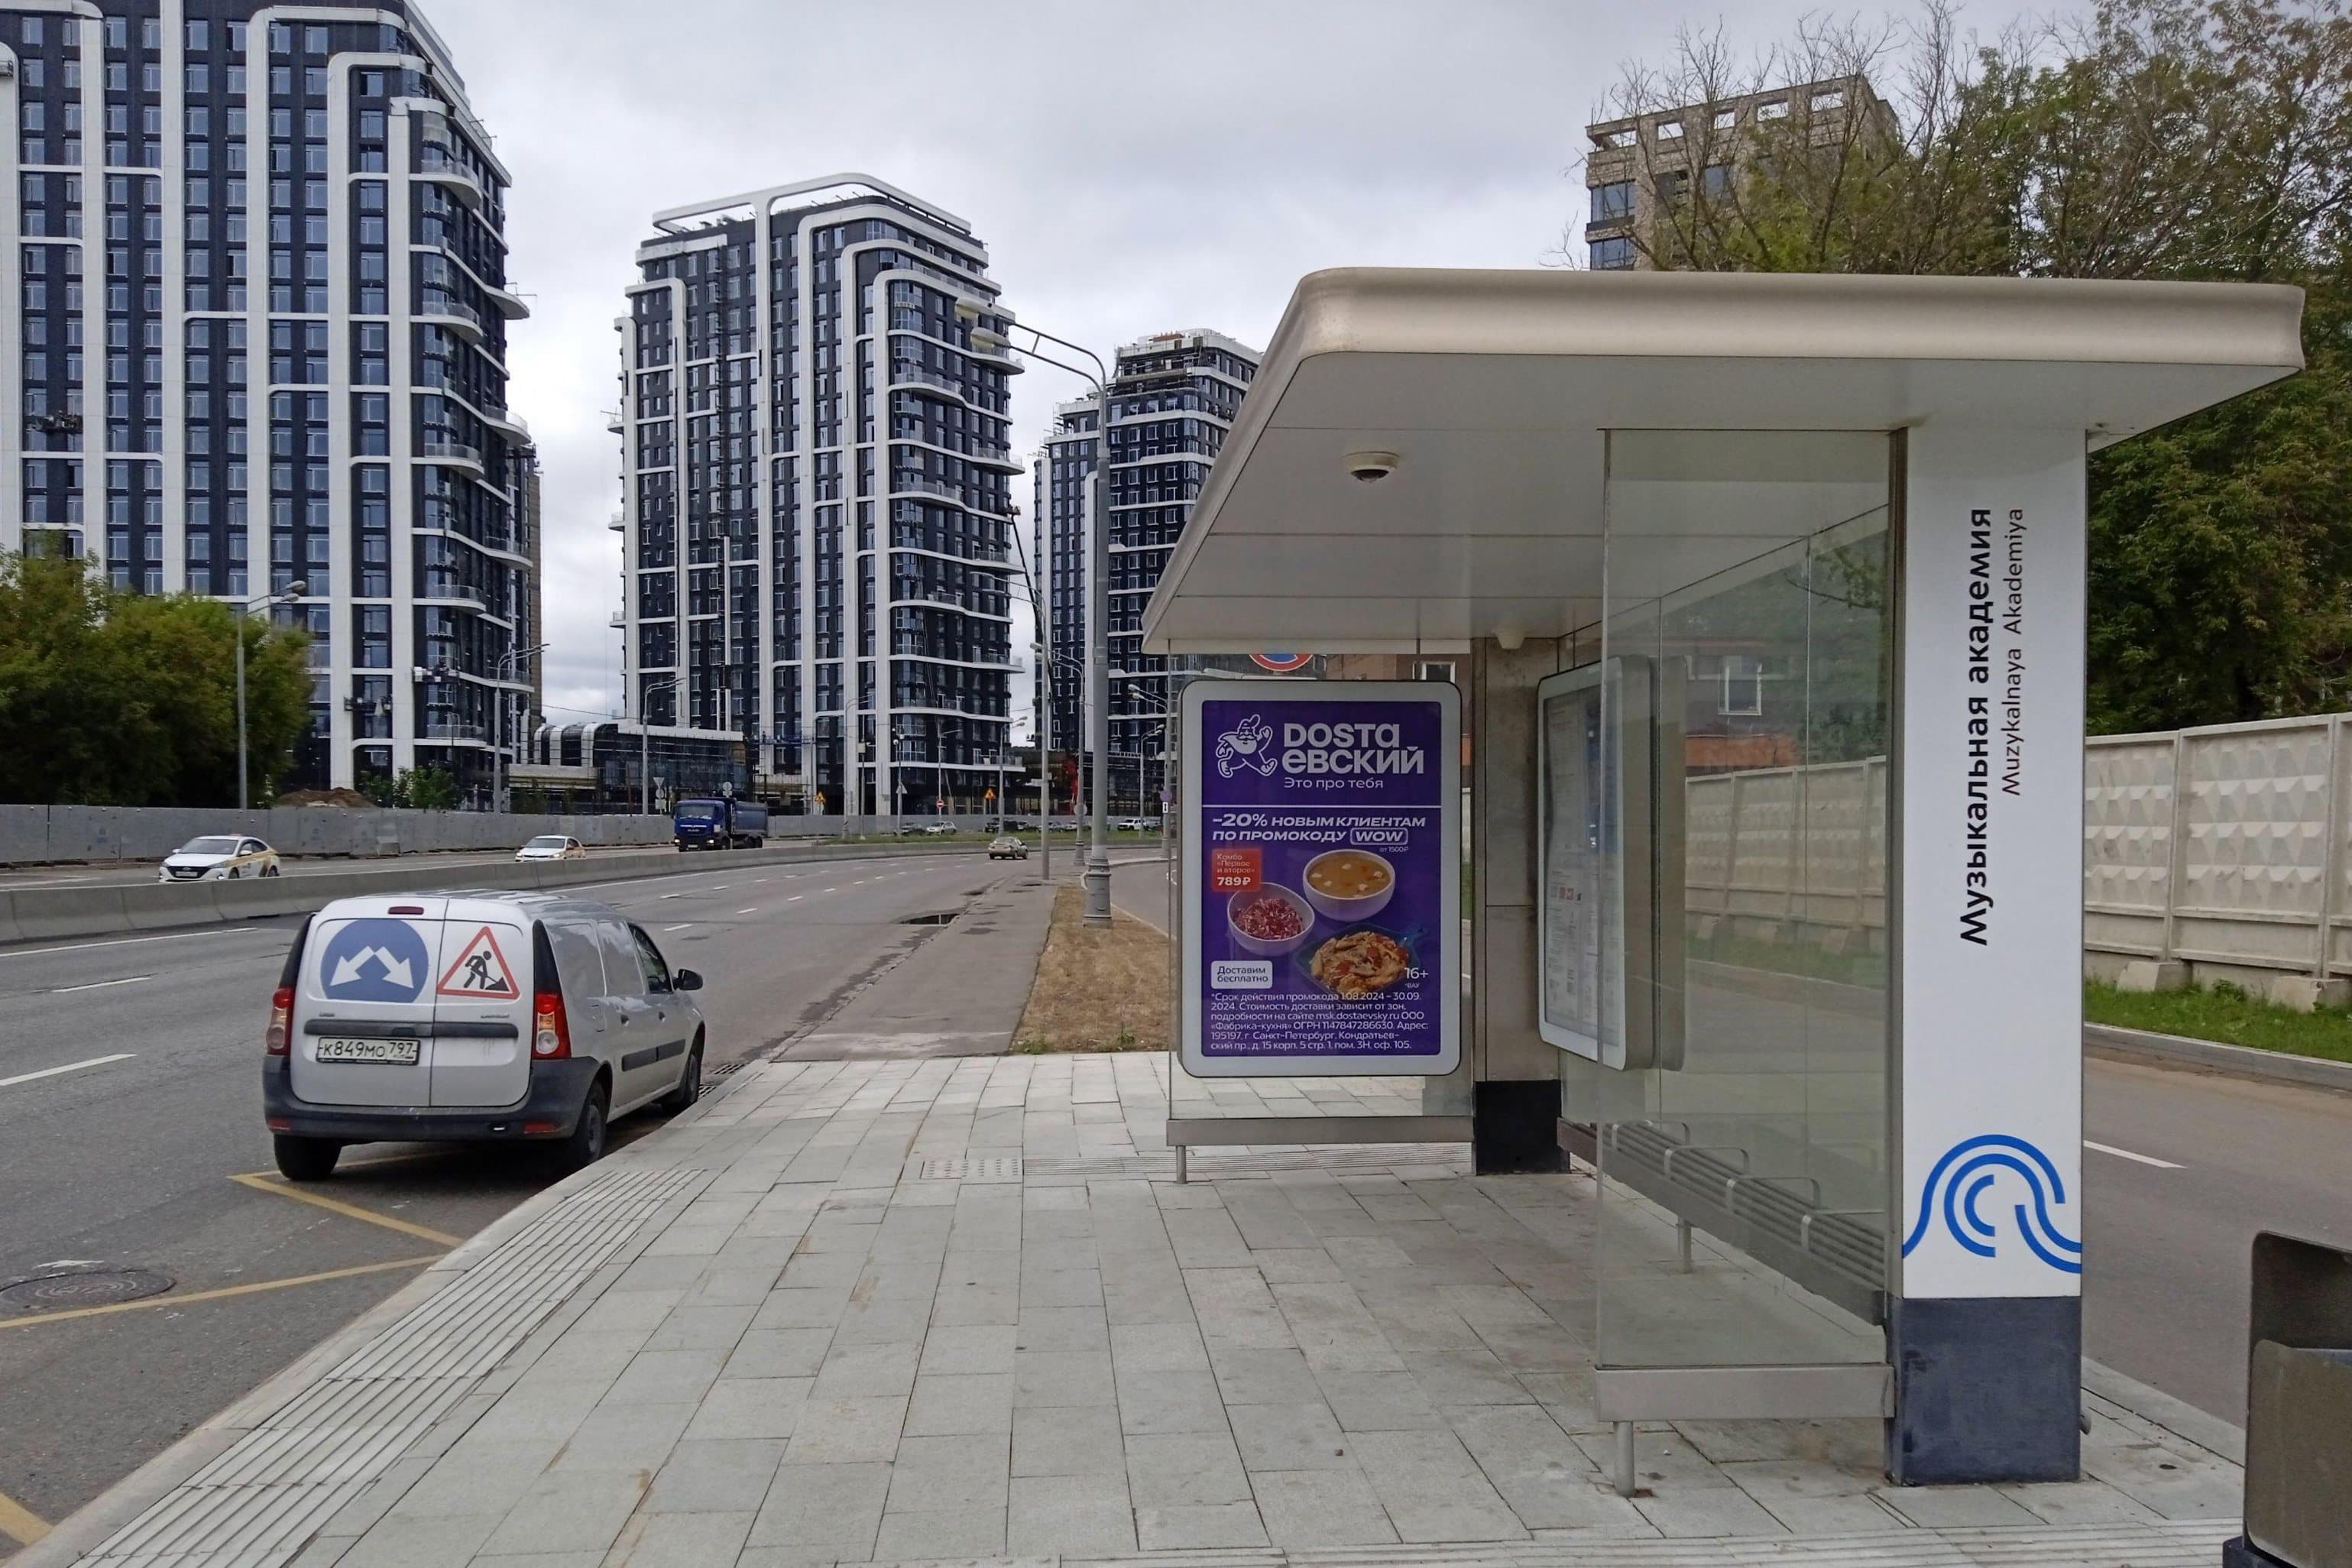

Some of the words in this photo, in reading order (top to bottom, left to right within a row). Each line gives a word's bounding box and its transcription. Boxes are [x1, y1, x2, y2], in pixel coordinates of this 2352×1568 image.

[2003, 509, 2026, 635] Akademiya
[1969, 509, 1994, 683] академия
[2000, 648, 2026, 796] Muzykalnaya
[1284, 778, 1312, 789] Это
[1316, 779, 1344, 790] про
[1348, 777, 1384, 789] тебя
[1272, 817, 1336, 826] НОВЫМ
[1336, 817, 1426, 827] КЛИЕНТАМ
[1961, 697, 1994, 945] Музыкальная
[1213, 831, 1236, 841] ПО
[1239, 831, 1346, 843] ПРОМОКОДУ
[1355, 831, 1404, 841] WOW
[1217, 966, 1265, 975] Доставим
[1404, 967, 1428, 979] 16+
[1217, 974, 1268, 983] бесплатно
[1240, 993, 1285, 1002] действия
[1239, 1002, 1290, 1010] Стоимость
[1210, 1012, 1273, 1021] подробности
[1316, 1011, 1399, 1022] msk.dostaevsky.ru
[1397, 1022, 1428, 1031] Адрес:
[1339, 1032, 1400, 1041] Кондратьев-
[389, 1042, 413, 1054] 797
[1210, 1042, 1233, 1050] ский
[1394, 1041, 1411, 1049] 105.
